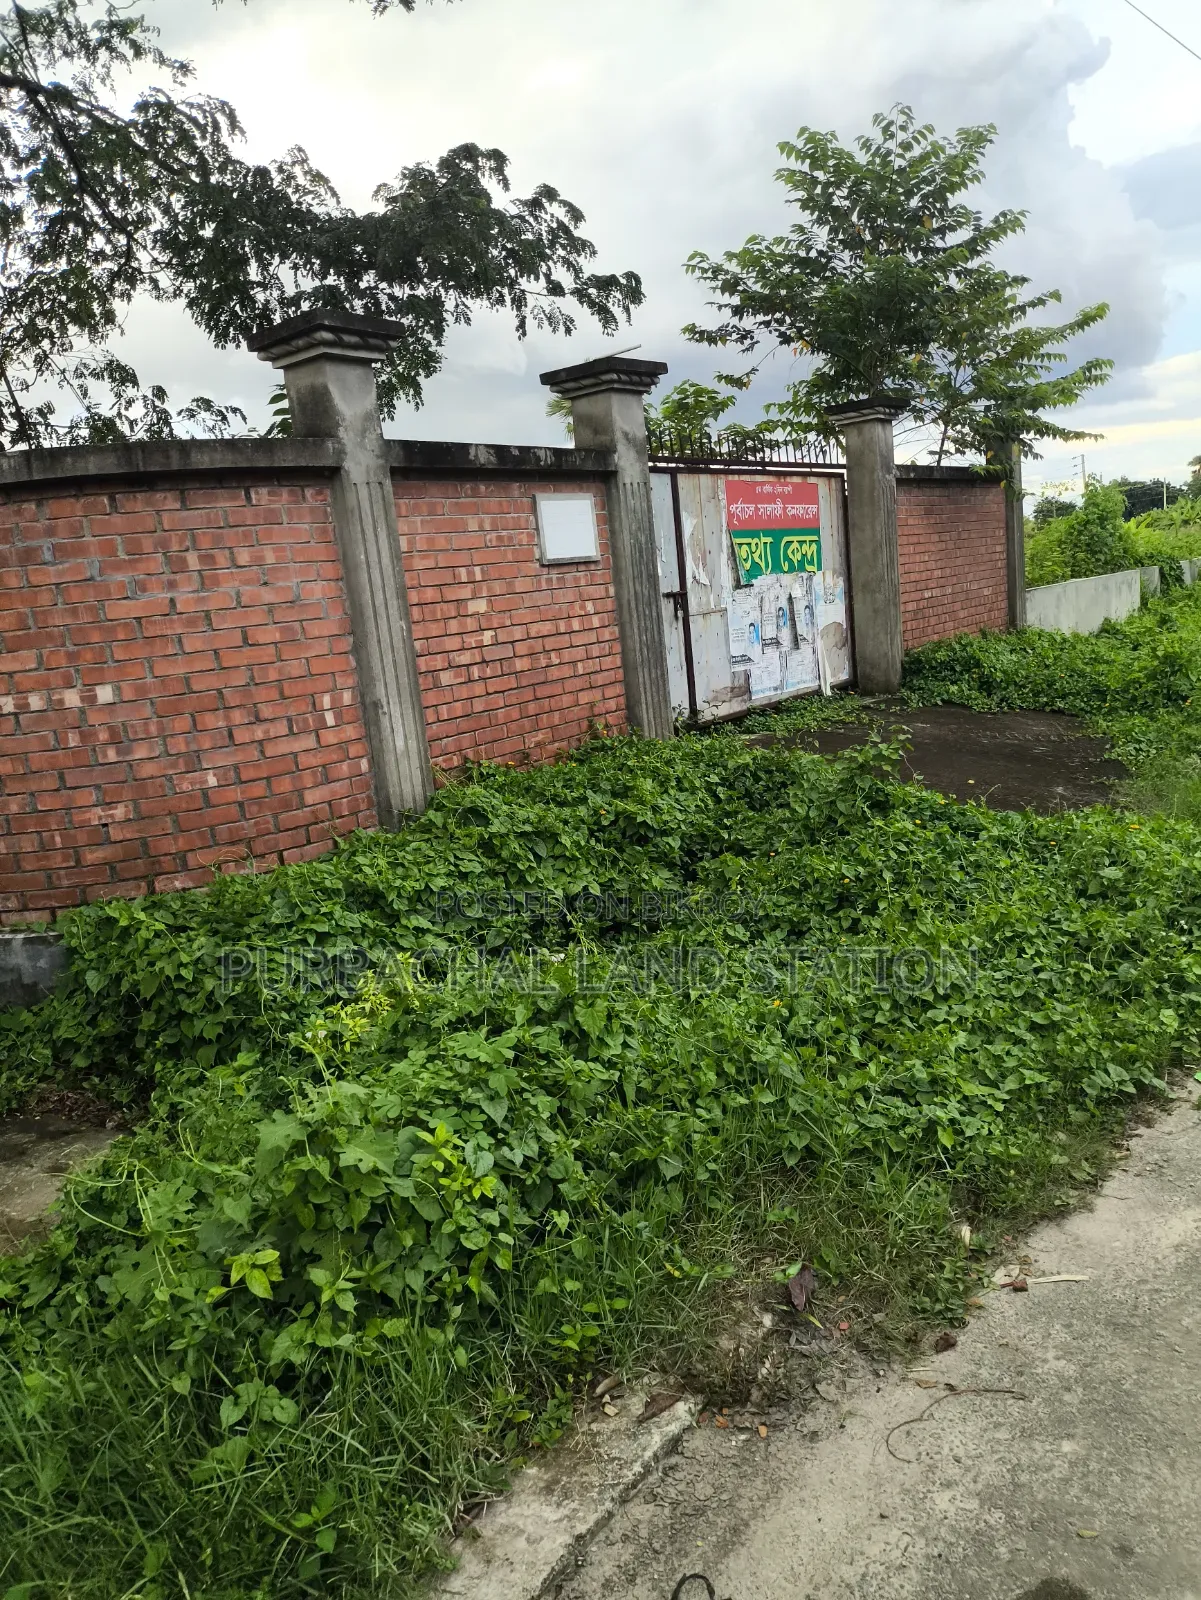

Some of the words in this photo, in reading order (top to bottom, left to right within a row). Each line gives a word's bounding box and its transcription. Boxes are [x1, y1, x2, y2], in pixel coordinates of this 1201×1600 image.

[729, 497, 756, 526] পূর্বাচল
[757, 498, 784, 520] সালাফী
[734, 531, 773, 575] তথ্য
[780, 535, 819, 575] কেন্দ্র
